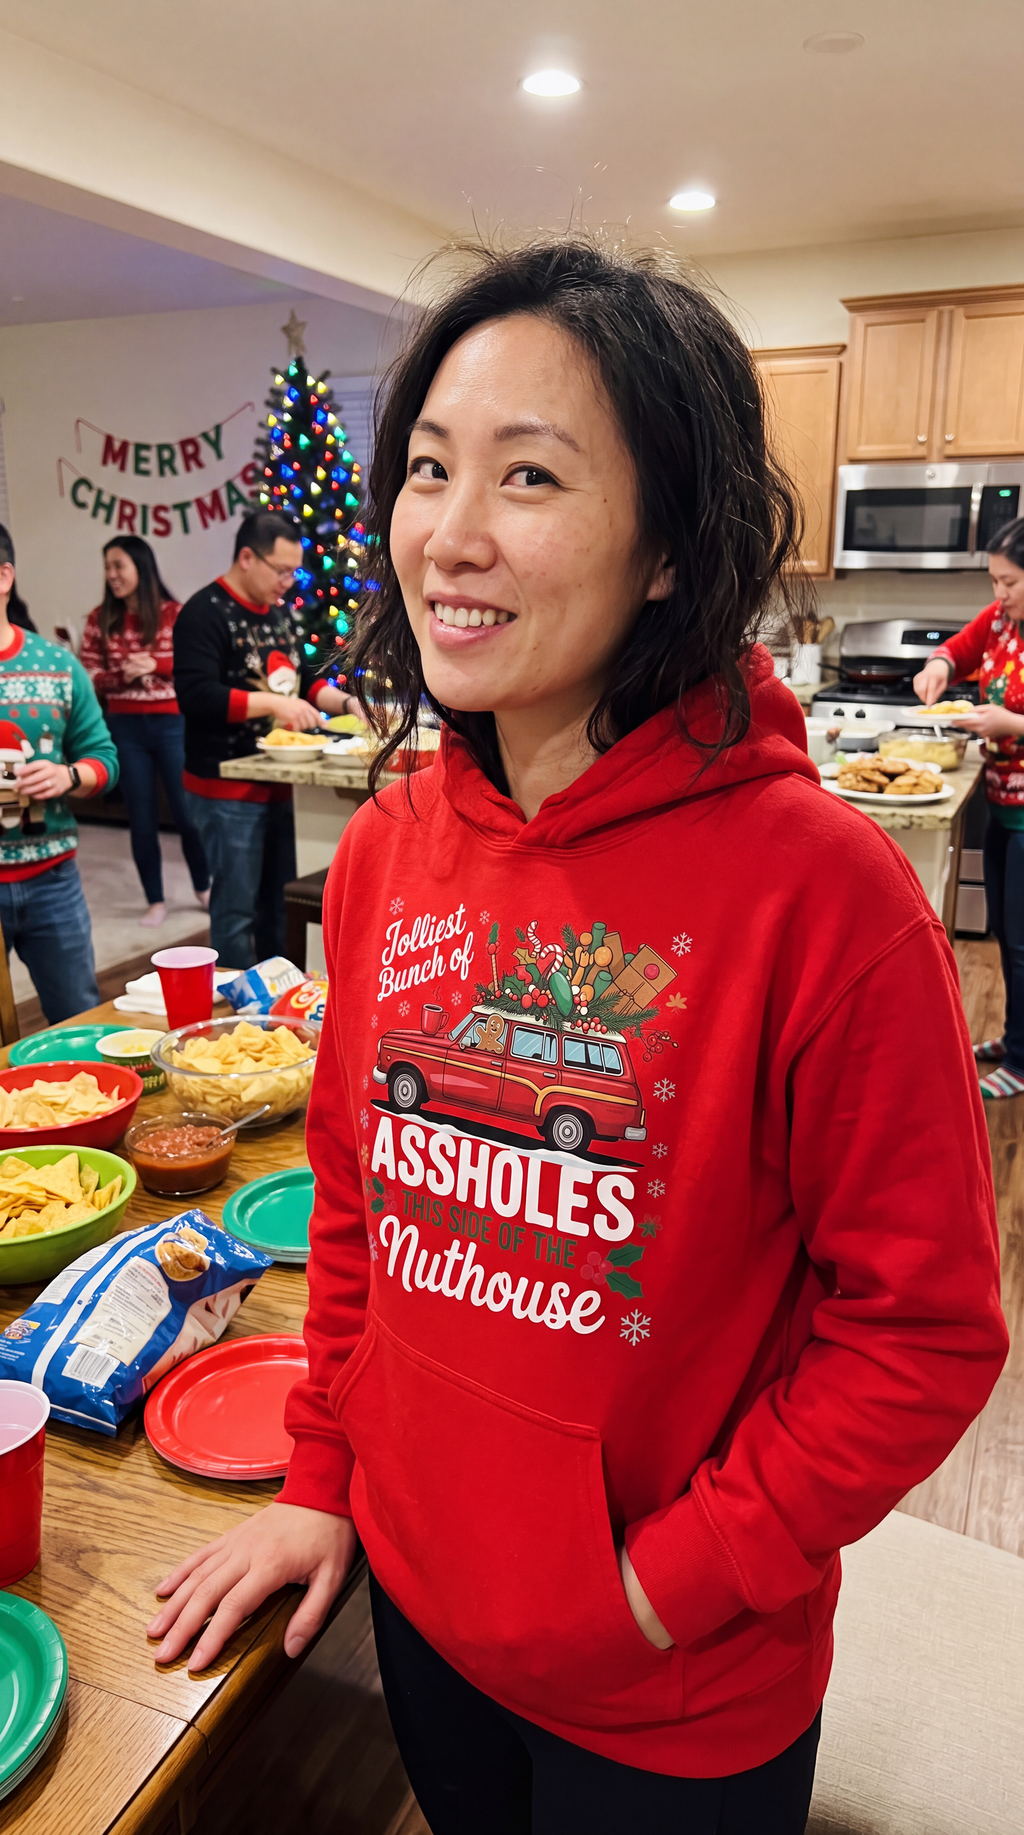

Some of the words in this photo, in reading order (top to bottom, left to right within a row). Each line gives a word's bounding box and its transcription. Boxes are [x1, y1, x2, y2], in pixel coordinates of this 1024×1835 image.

[101, 423, 225, 478] MERRY
[377, 944, 446, 1002] Bunch
[450, 931, 475, 981] of
[381, 903, 467, 966] Jolliest
[371, 1116, 635, 1242] ASSHOLES
[401, 1189, 443, 1228] THIS
[448, 1205, 492, 1244] SIDE
[498, 1222, 526, 1253] OF
[533, 1231, 578, 1269] THE
[379, 1215, 606, 1334] Nuthouse
